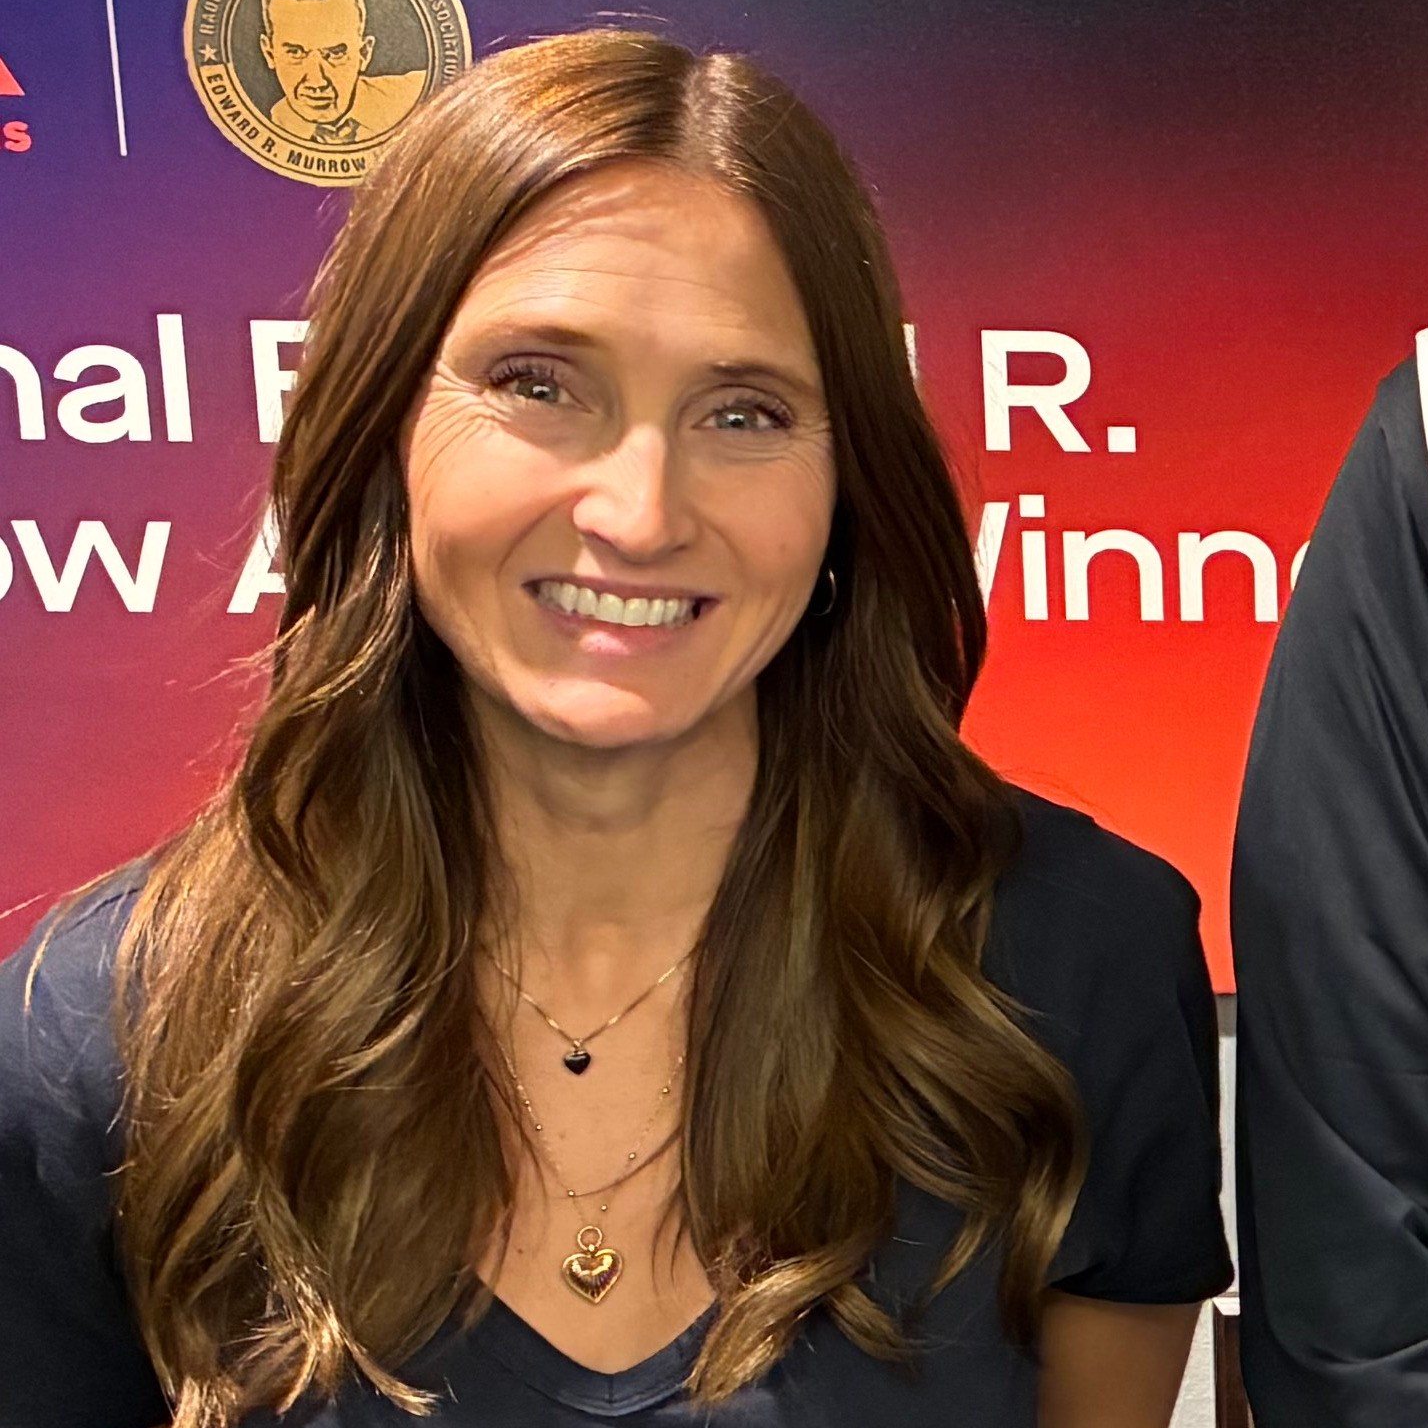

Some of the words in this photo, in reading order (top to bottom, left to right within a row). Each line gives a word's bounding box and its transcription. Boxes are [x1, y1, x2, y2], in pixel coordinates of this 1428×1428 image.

[206, 73, 260, 138] EDWARD
[261, 136, 277, 158] R.
[287, 150, 366, 173] MURROW
[980, 329, 1136, 453] R.
[0, 520, 171, 614] w
[974, 494, 1311, 623] inn
